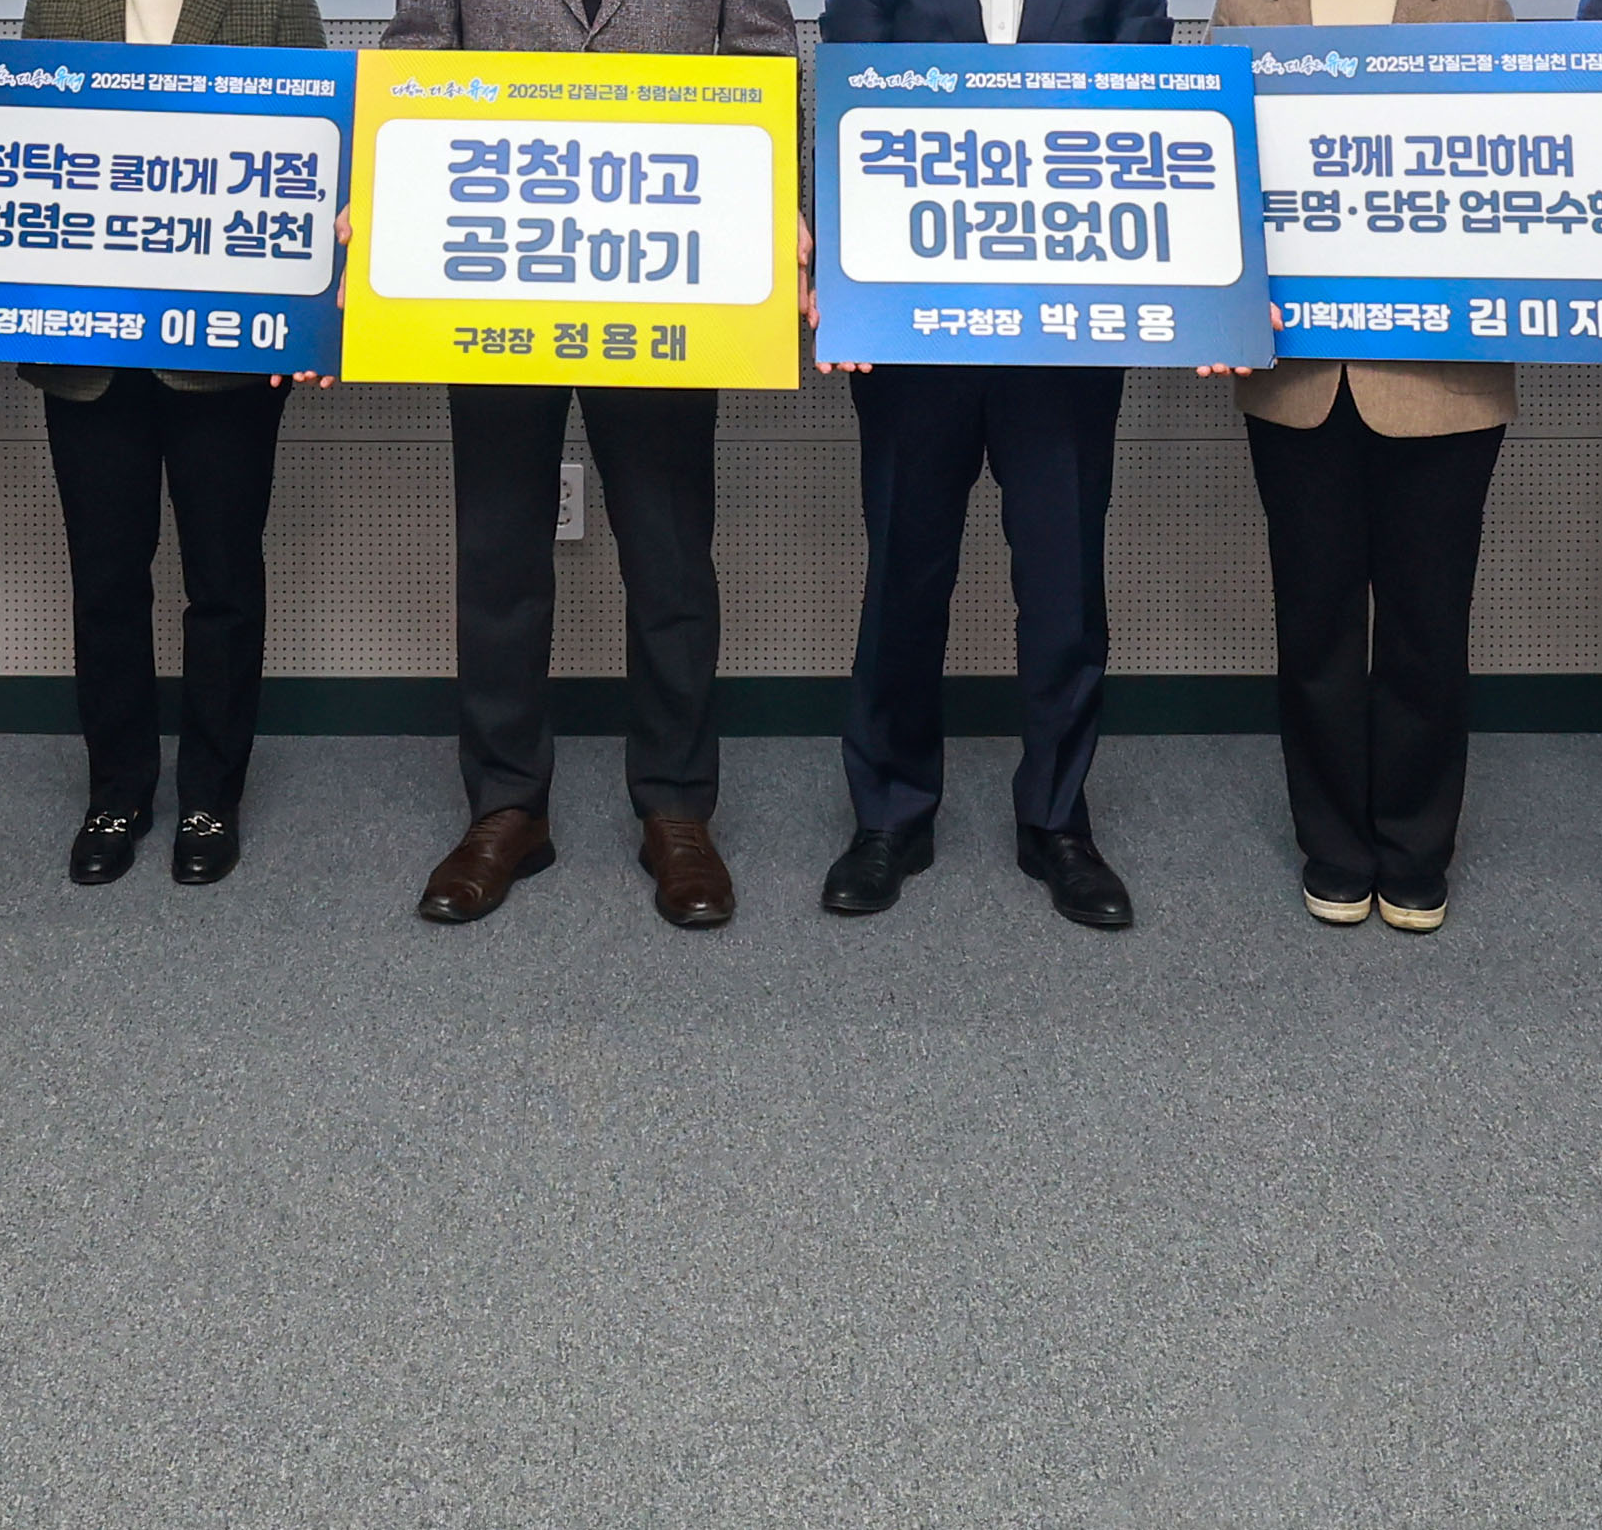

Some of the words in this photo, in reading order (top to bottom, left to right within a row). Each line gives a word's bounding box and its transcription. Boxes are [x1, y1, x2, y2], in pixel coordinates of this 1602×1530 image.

[965, 72, 1021, 89] 2025년
[1159, 74, 1221, 91] 다짐대회
[1366, 56, 1425, 73] 2025년
[91, 72, 145, 90] 2025년
[276, 78, 335, 98] 다짐대회
[508, 84, 563, 100] 2025년
[702, 87, 762, 104] 다짐대회
[448, 139, 701, 204] 경청하고
[860, 129, 1032, 188] 격려와
[1044, 131, 1215, 189] 응원은
[1310, 134, 1393, 178] 함께
[1404, 134, 1574, 178] 고민하며
[110, 154, 218, 195] 쿨하게
[228, 151, 326, 203] 거절,
[103, 215, 210, 255] 뜨겁게
[223, 211, 313, 260] 실천
[909, 200, 1171, 262] 아낌없이
[443, 216, 699, 284] 공감하기
[912, 307, 1023, 336] 부구청장
[1284, 302, 1450, 332] 기획재정국장
[454, 327, 535, 355] 구청장
